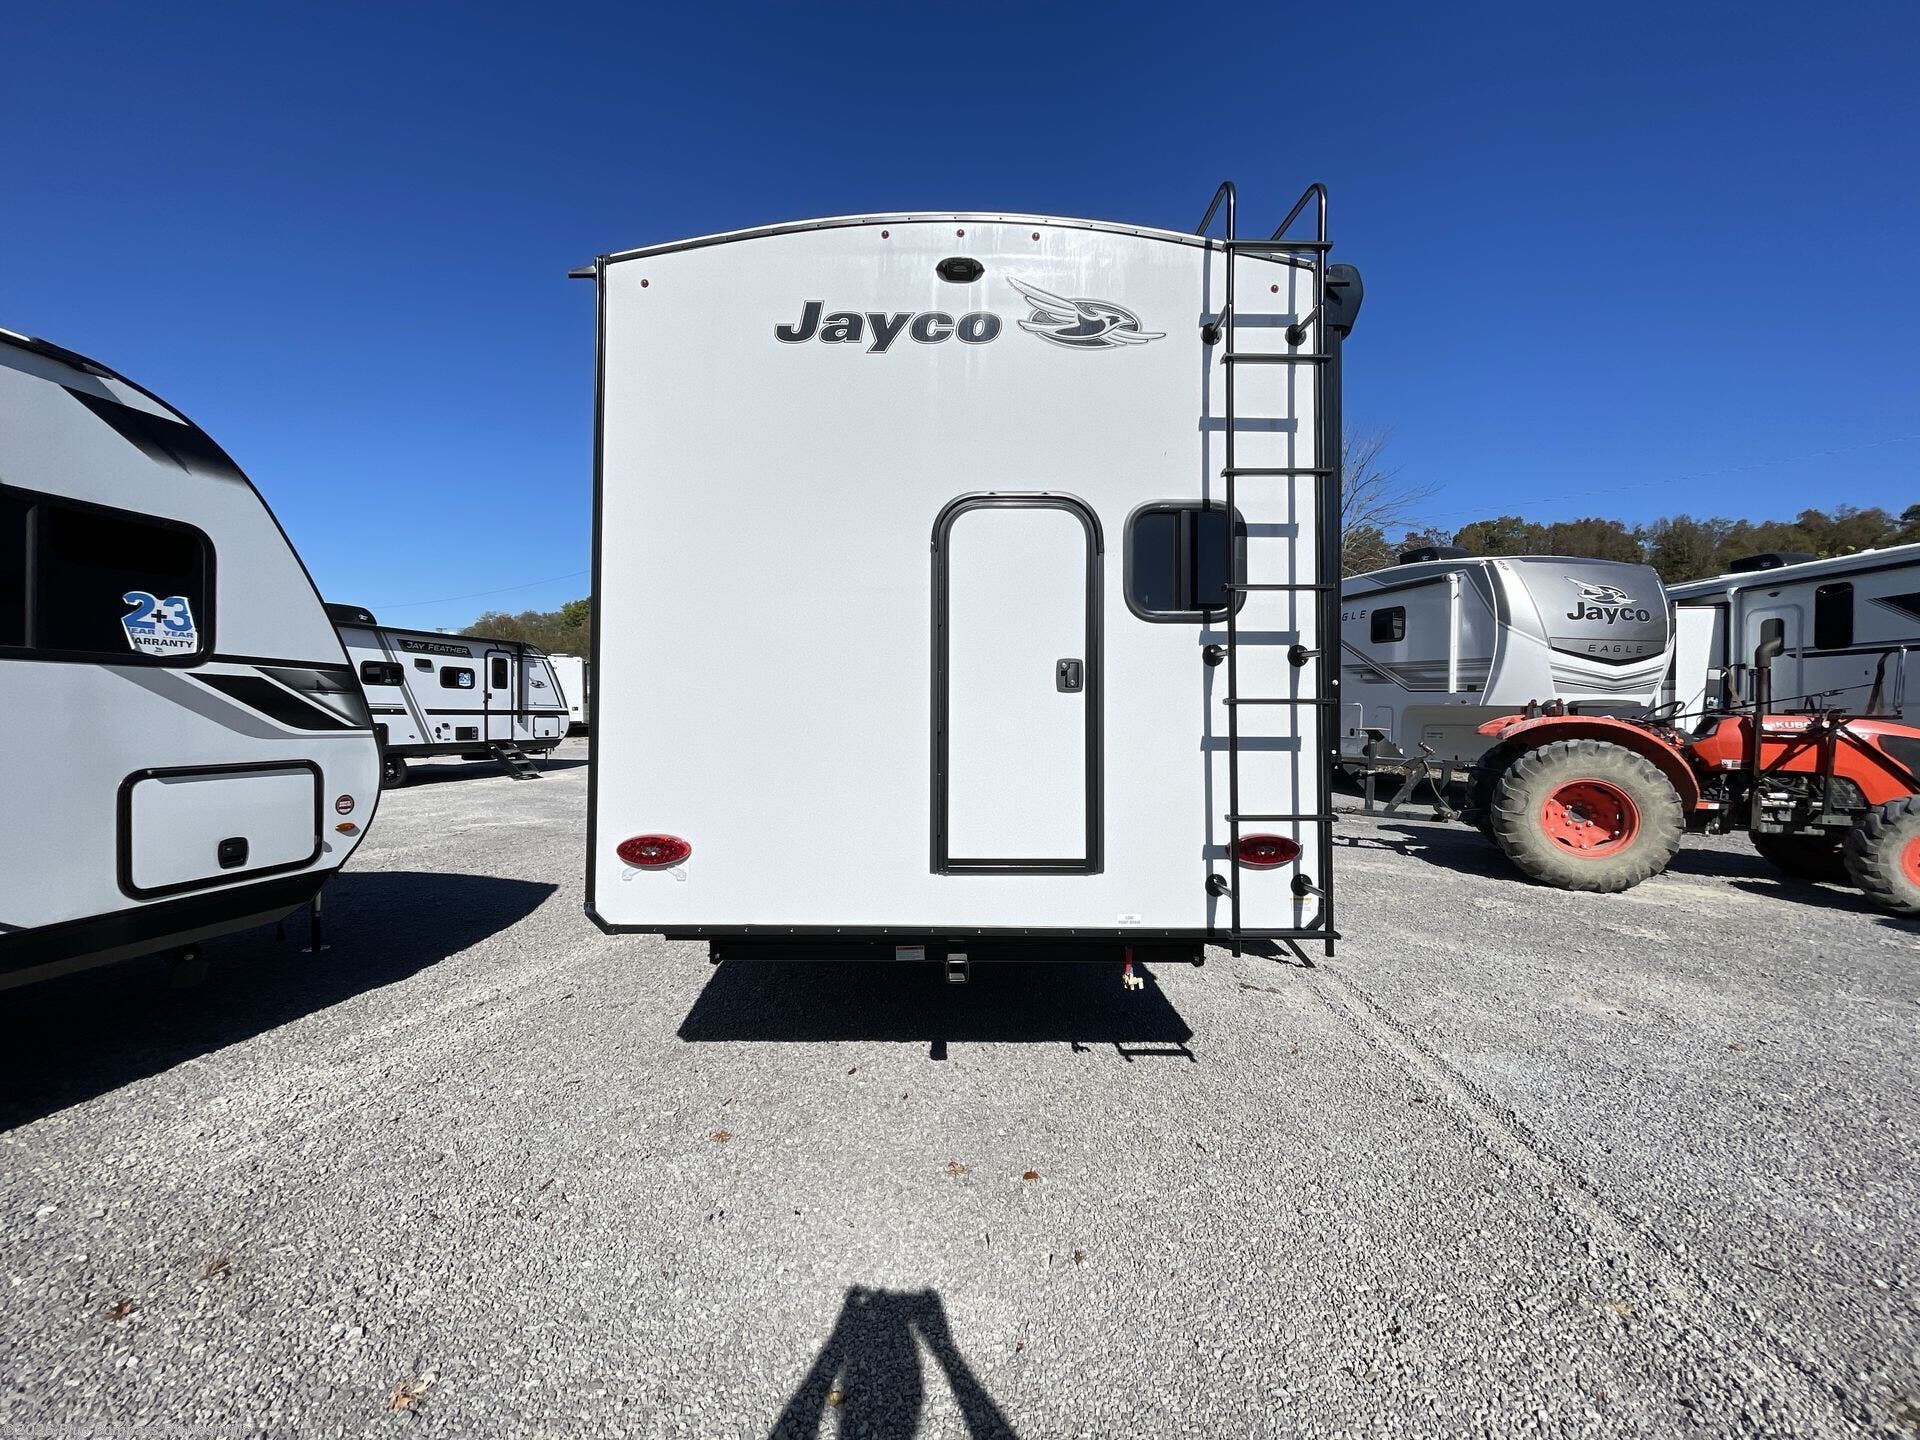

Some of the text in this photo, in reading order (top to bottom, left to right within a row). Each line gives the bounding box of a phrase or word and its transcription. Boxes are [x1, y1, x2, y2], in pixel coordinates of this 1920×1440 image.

[774, 300, 1003, 354] Jayco
[1341, 610, 1367, 622] GLE
[1566, 601, 1651, 625] Jayco
[128, 627, 194, 639] EAR YEAR
[133, 636, 194, 649] ARRANTY
[406, 641, 469, 655] JAY FEATHER
[1587, 644, 1644, 654] EAGLE
